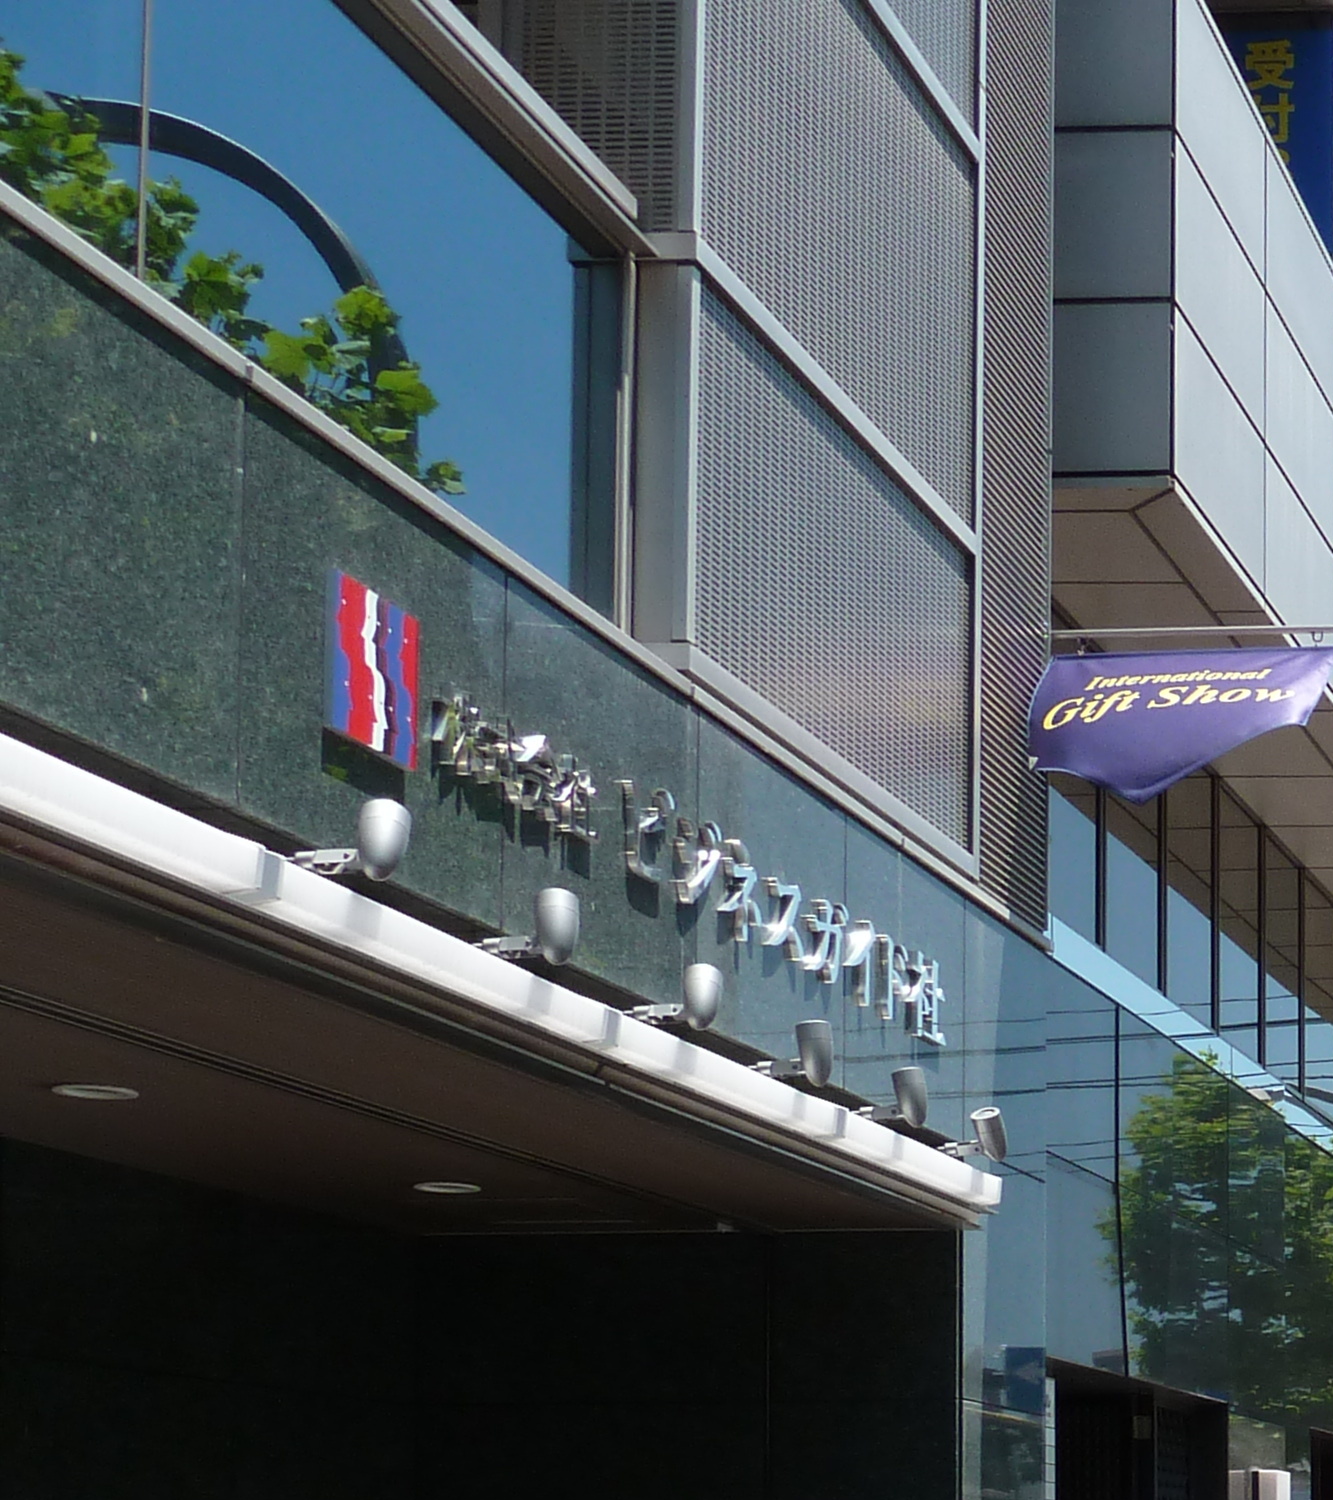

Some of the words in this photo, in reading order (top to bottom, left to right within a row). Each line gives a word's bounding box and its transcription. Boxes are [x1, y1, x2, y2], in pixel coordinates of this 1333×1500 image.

[1083, 668, 1271, 691] International
[1042, 688, 1140, 731] Gift
[1147, 684, 1295, 710] Show
